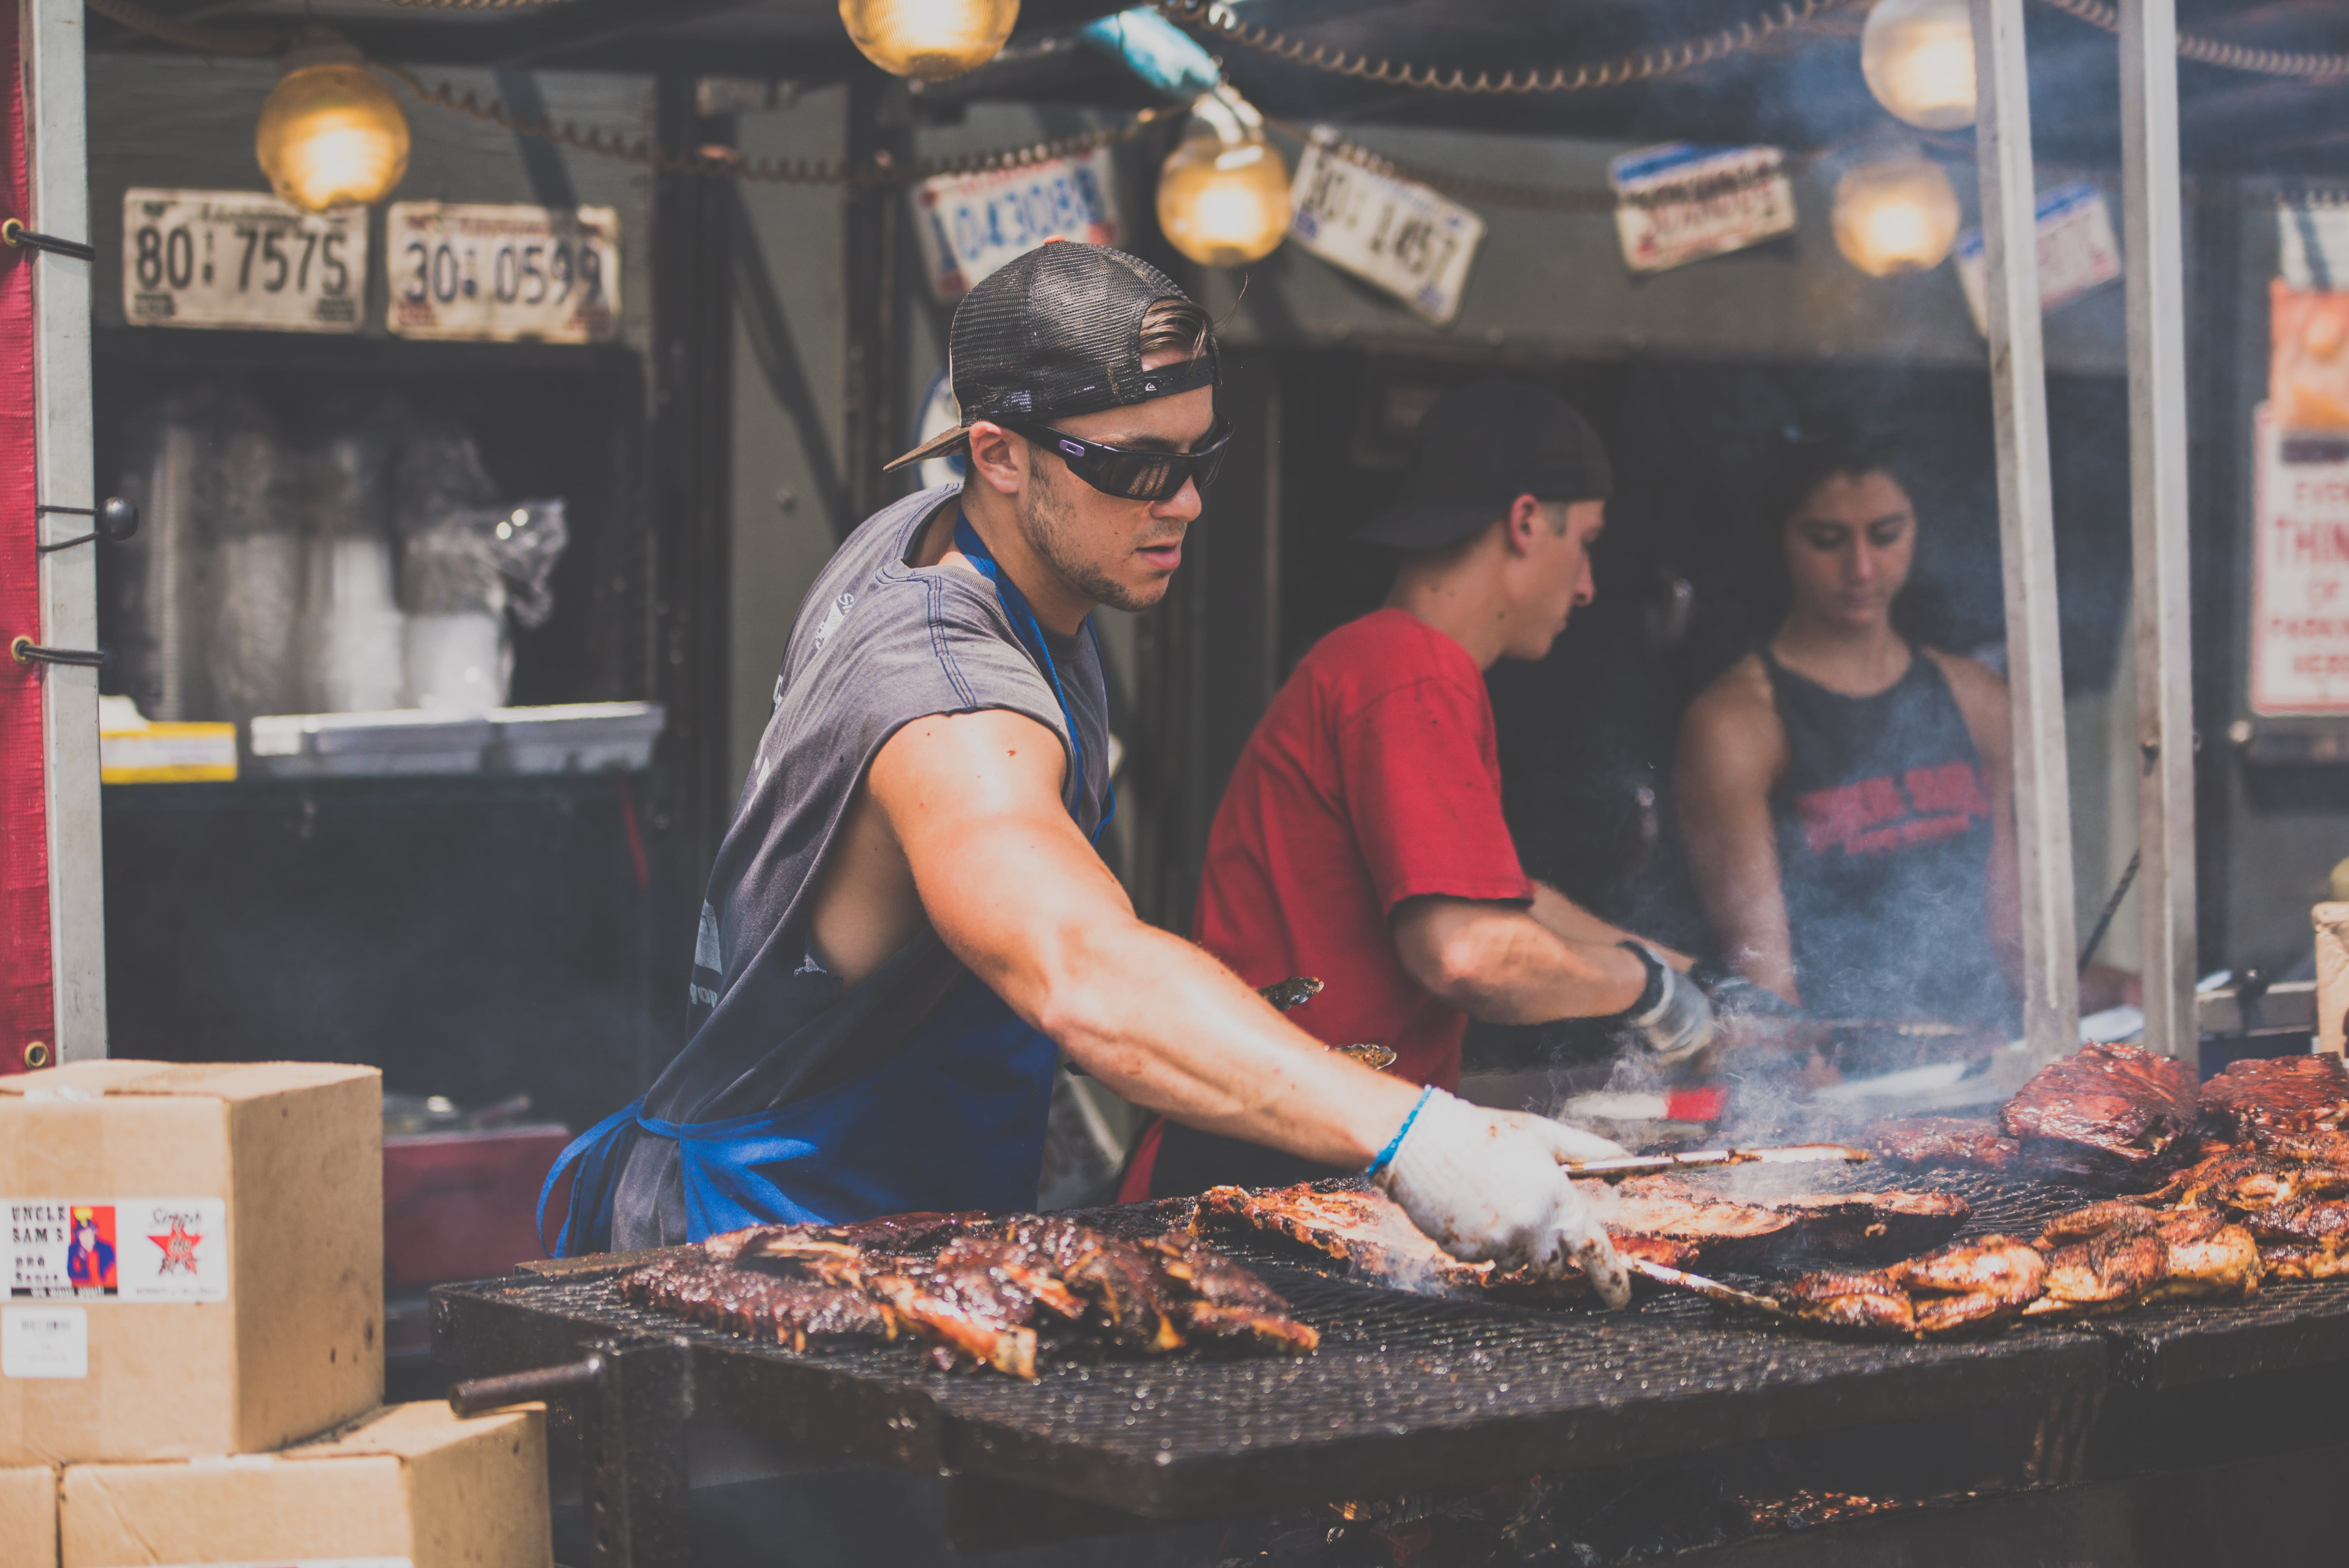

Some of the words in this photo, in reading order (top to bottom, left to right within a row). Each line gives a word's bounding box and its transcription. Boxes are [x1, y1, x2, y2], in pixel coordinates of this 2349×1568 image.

[137, 225, 193, 289] 80
[236, 228, 349, 295] 7575
[405, 243, 458, 302] 30
[496, 243, 603, 306] 0599
[12, 1206, 65, 1221] UNCLE
